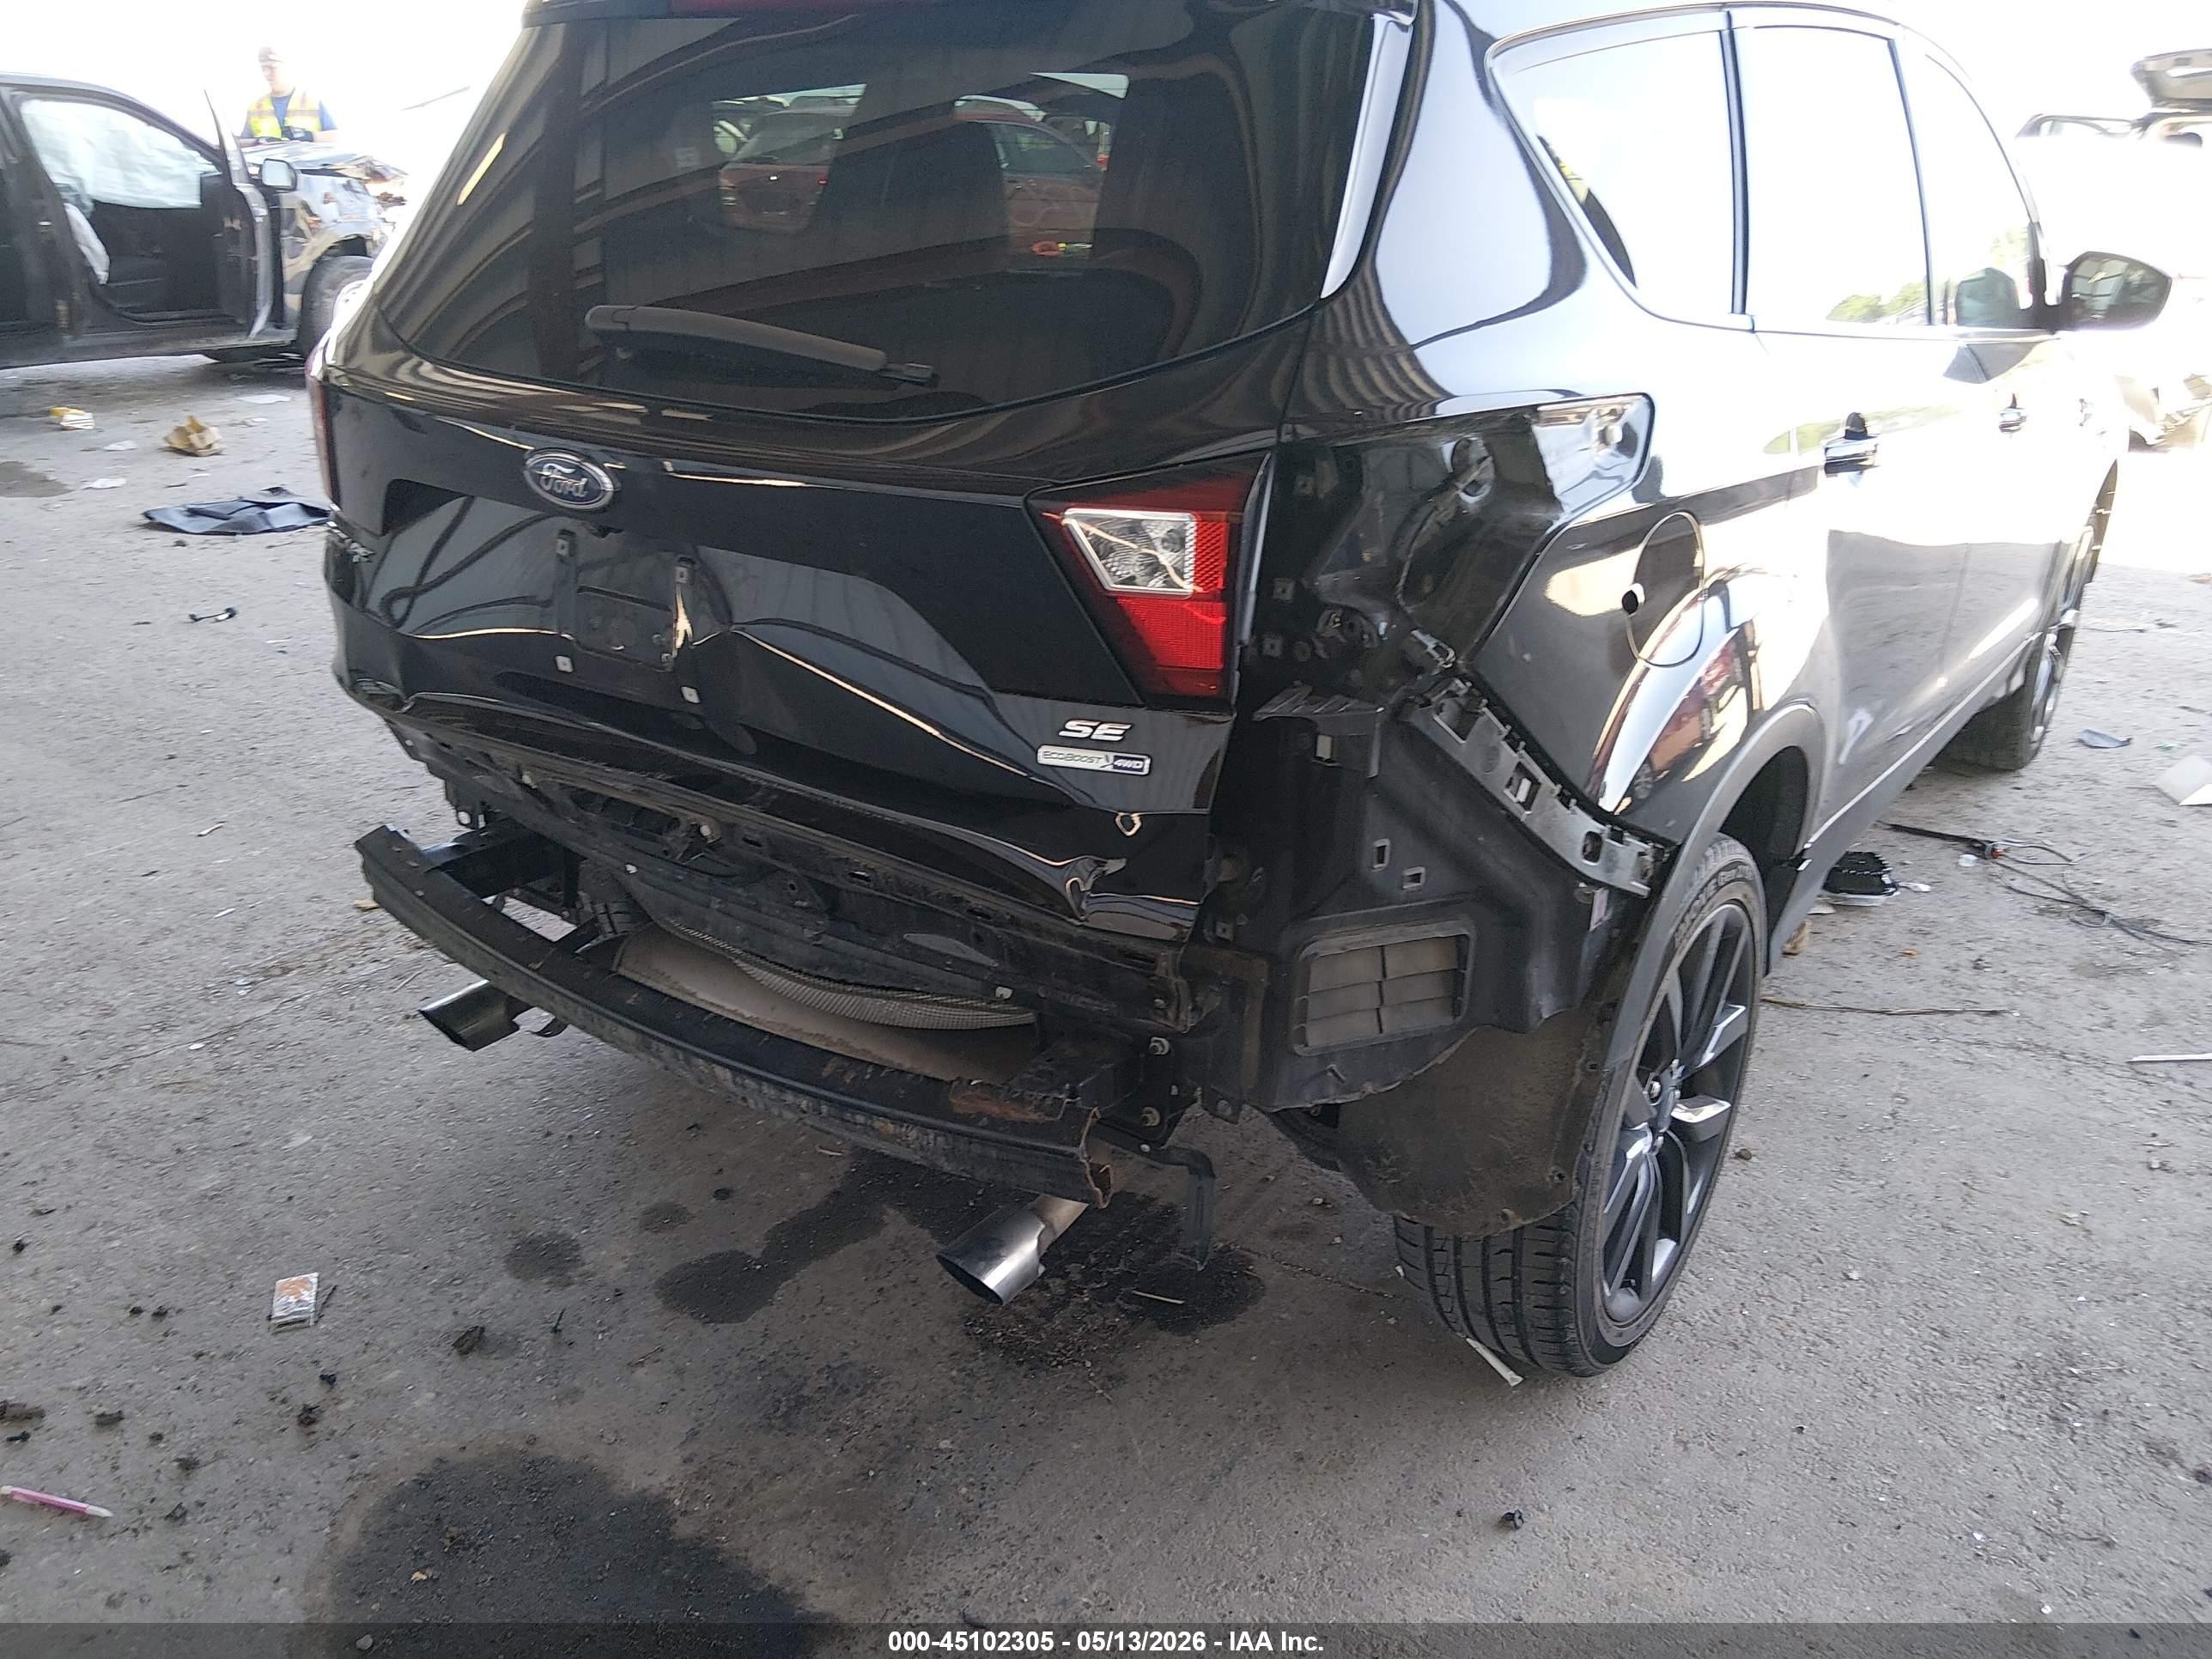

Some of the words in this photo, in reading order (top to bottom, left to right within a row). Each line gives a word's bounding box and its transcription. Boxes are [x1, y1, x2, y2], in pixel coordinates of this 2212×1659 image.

[536, 463, 589, 497] Ford
[1058, 719, 1133, 742] SE
[1042, 750, 1104, 764] ECOBOOST
[1113, 758, 1145, 769] 4WD
